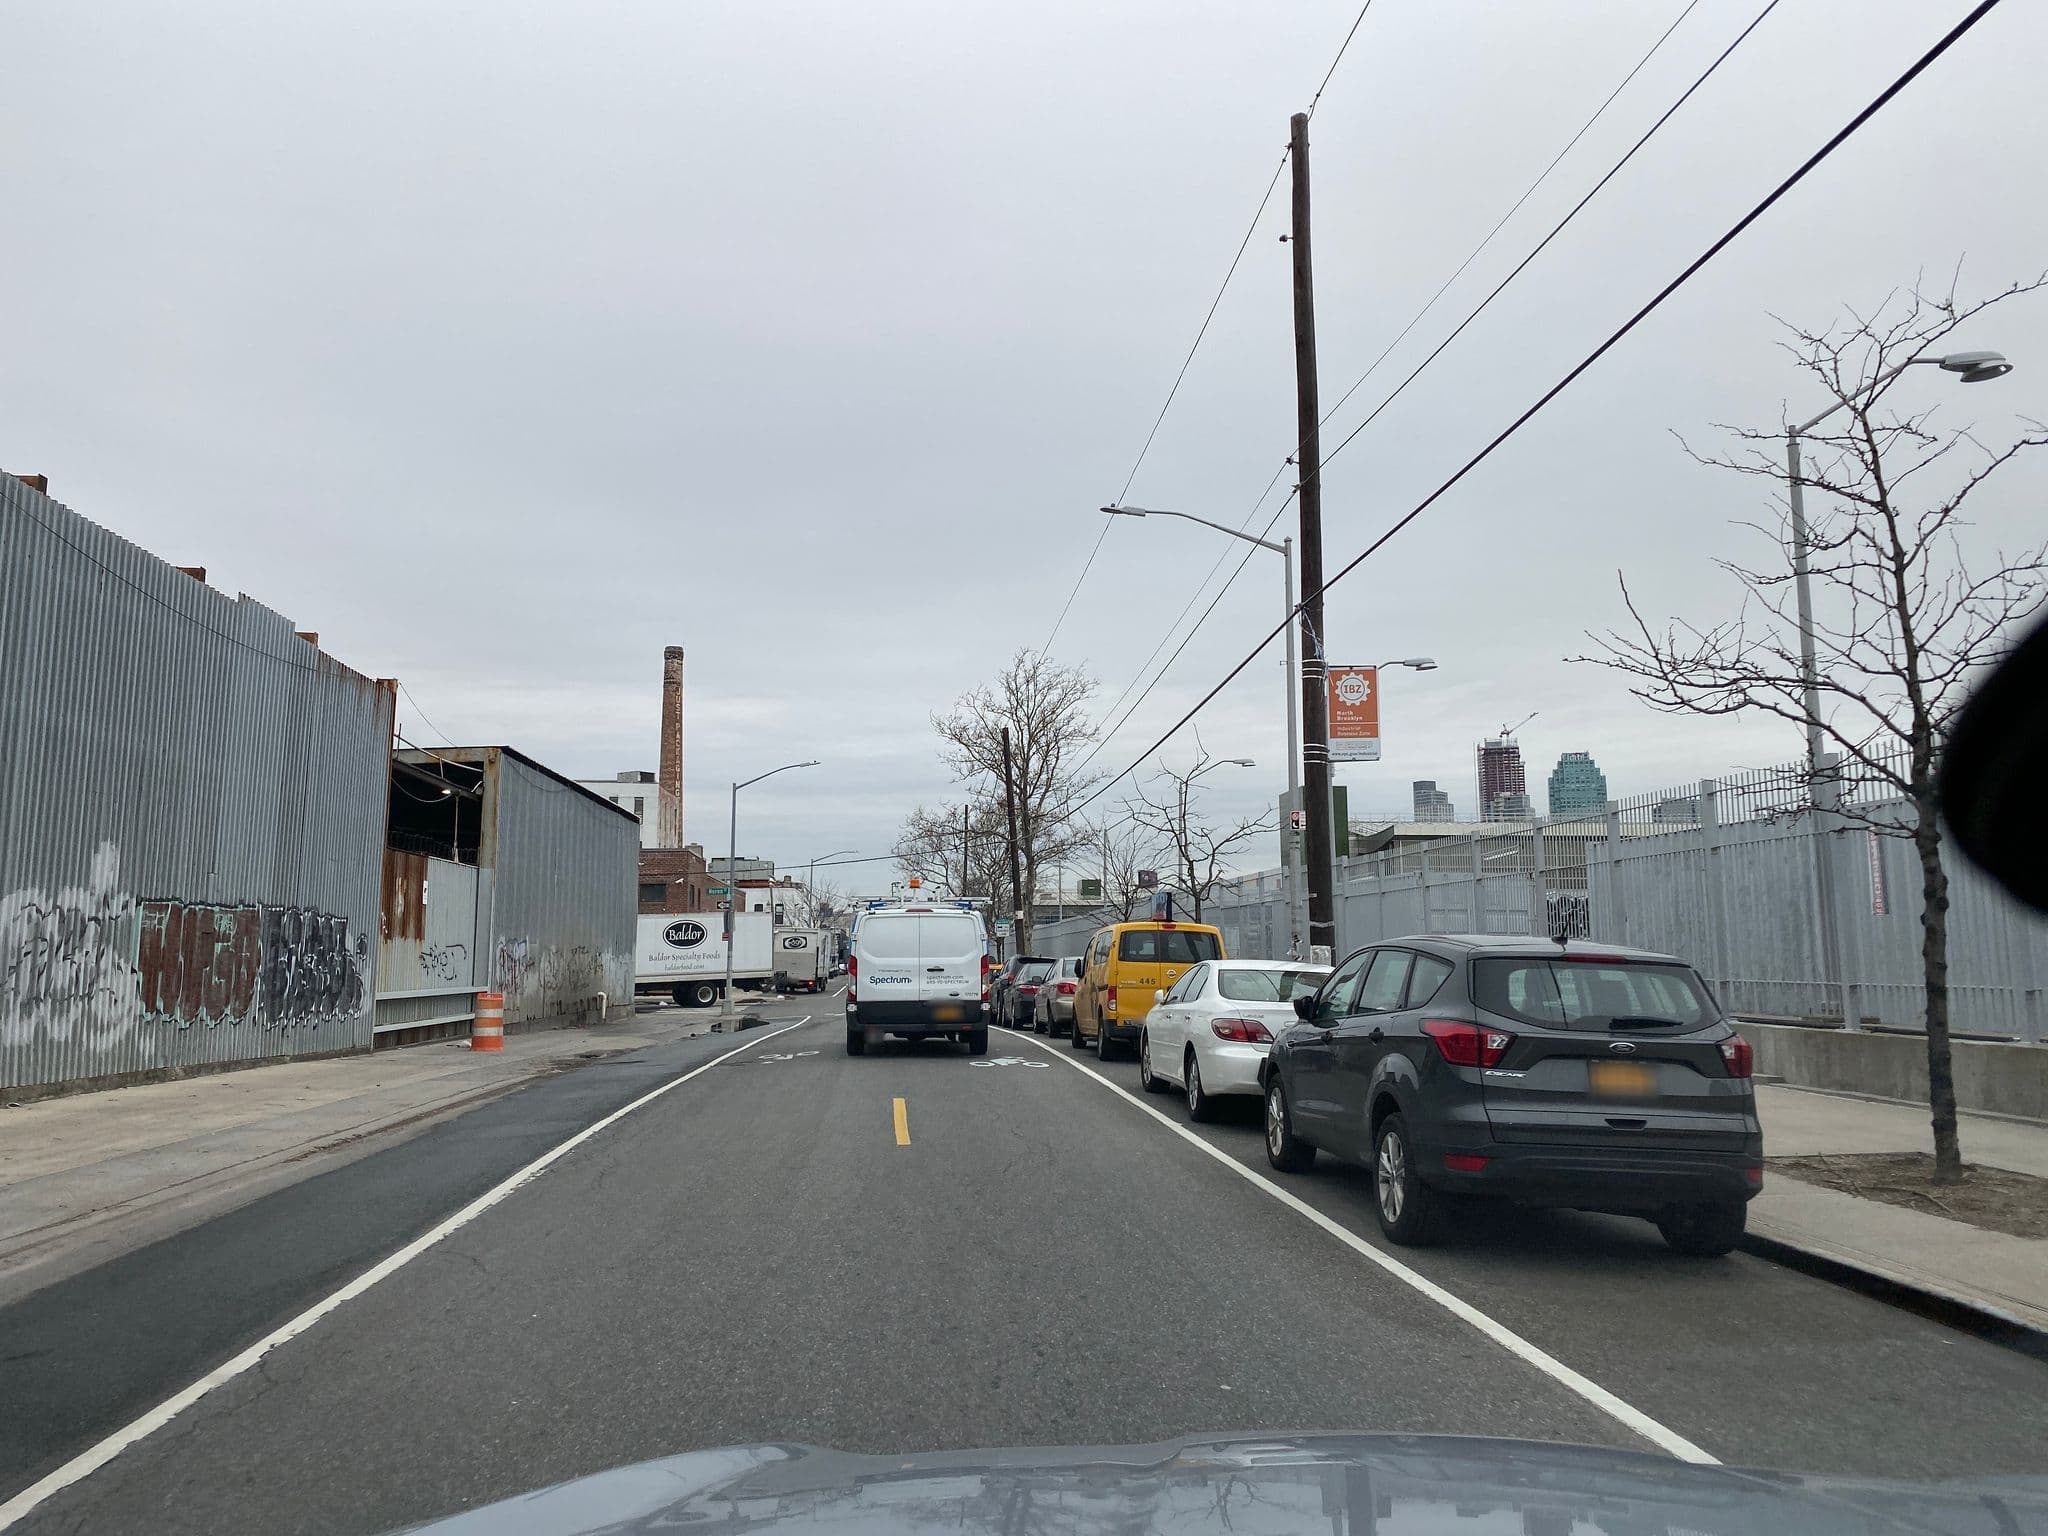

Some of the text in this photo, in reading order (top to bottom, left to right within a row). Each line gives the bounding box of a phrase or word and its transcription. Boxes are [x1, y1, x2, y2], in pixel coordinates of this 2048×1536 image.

[1344, 685, 1362, 694] IBZ
[668, 924, 702, 940] Baldor
[649, 950, 720, 962] Baldor Specialty Foods
[870, 976, 910, 985] Spectrum
